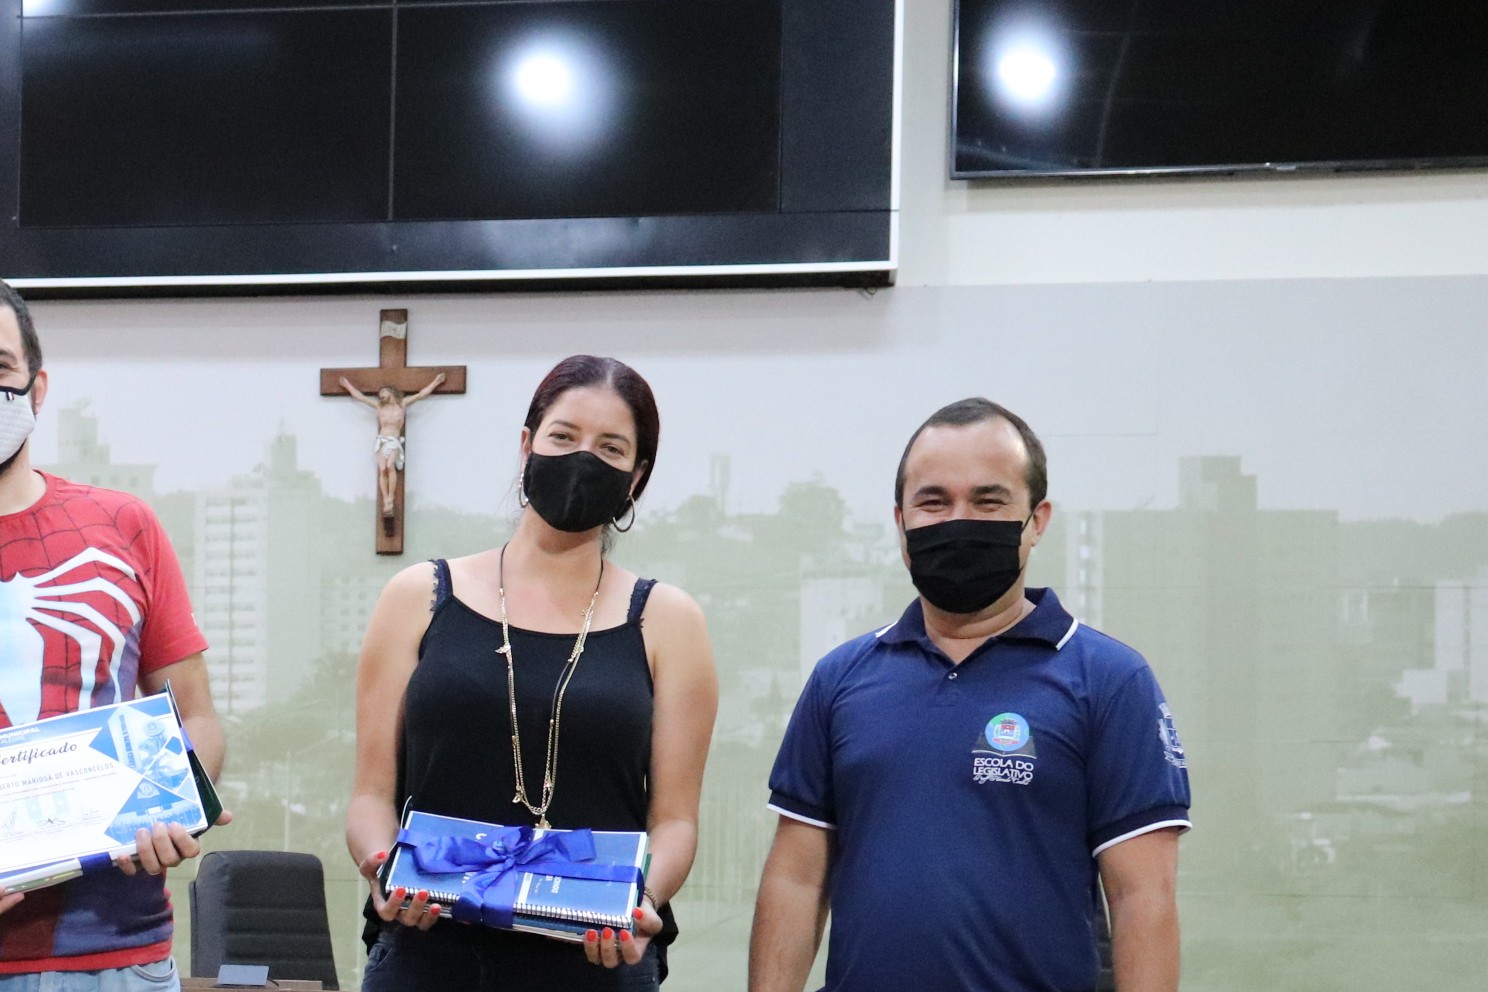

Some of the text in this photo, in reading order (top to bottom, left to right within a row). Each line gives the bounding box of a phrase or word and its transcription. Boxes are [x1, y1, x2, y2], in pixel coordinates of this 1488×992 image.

[0, 727, 41, 741] MUNICIPAL
[974, 757, 1034, 771] ESCOLA DO
[973, 766, 1033, 780] LEGISLATIVO
